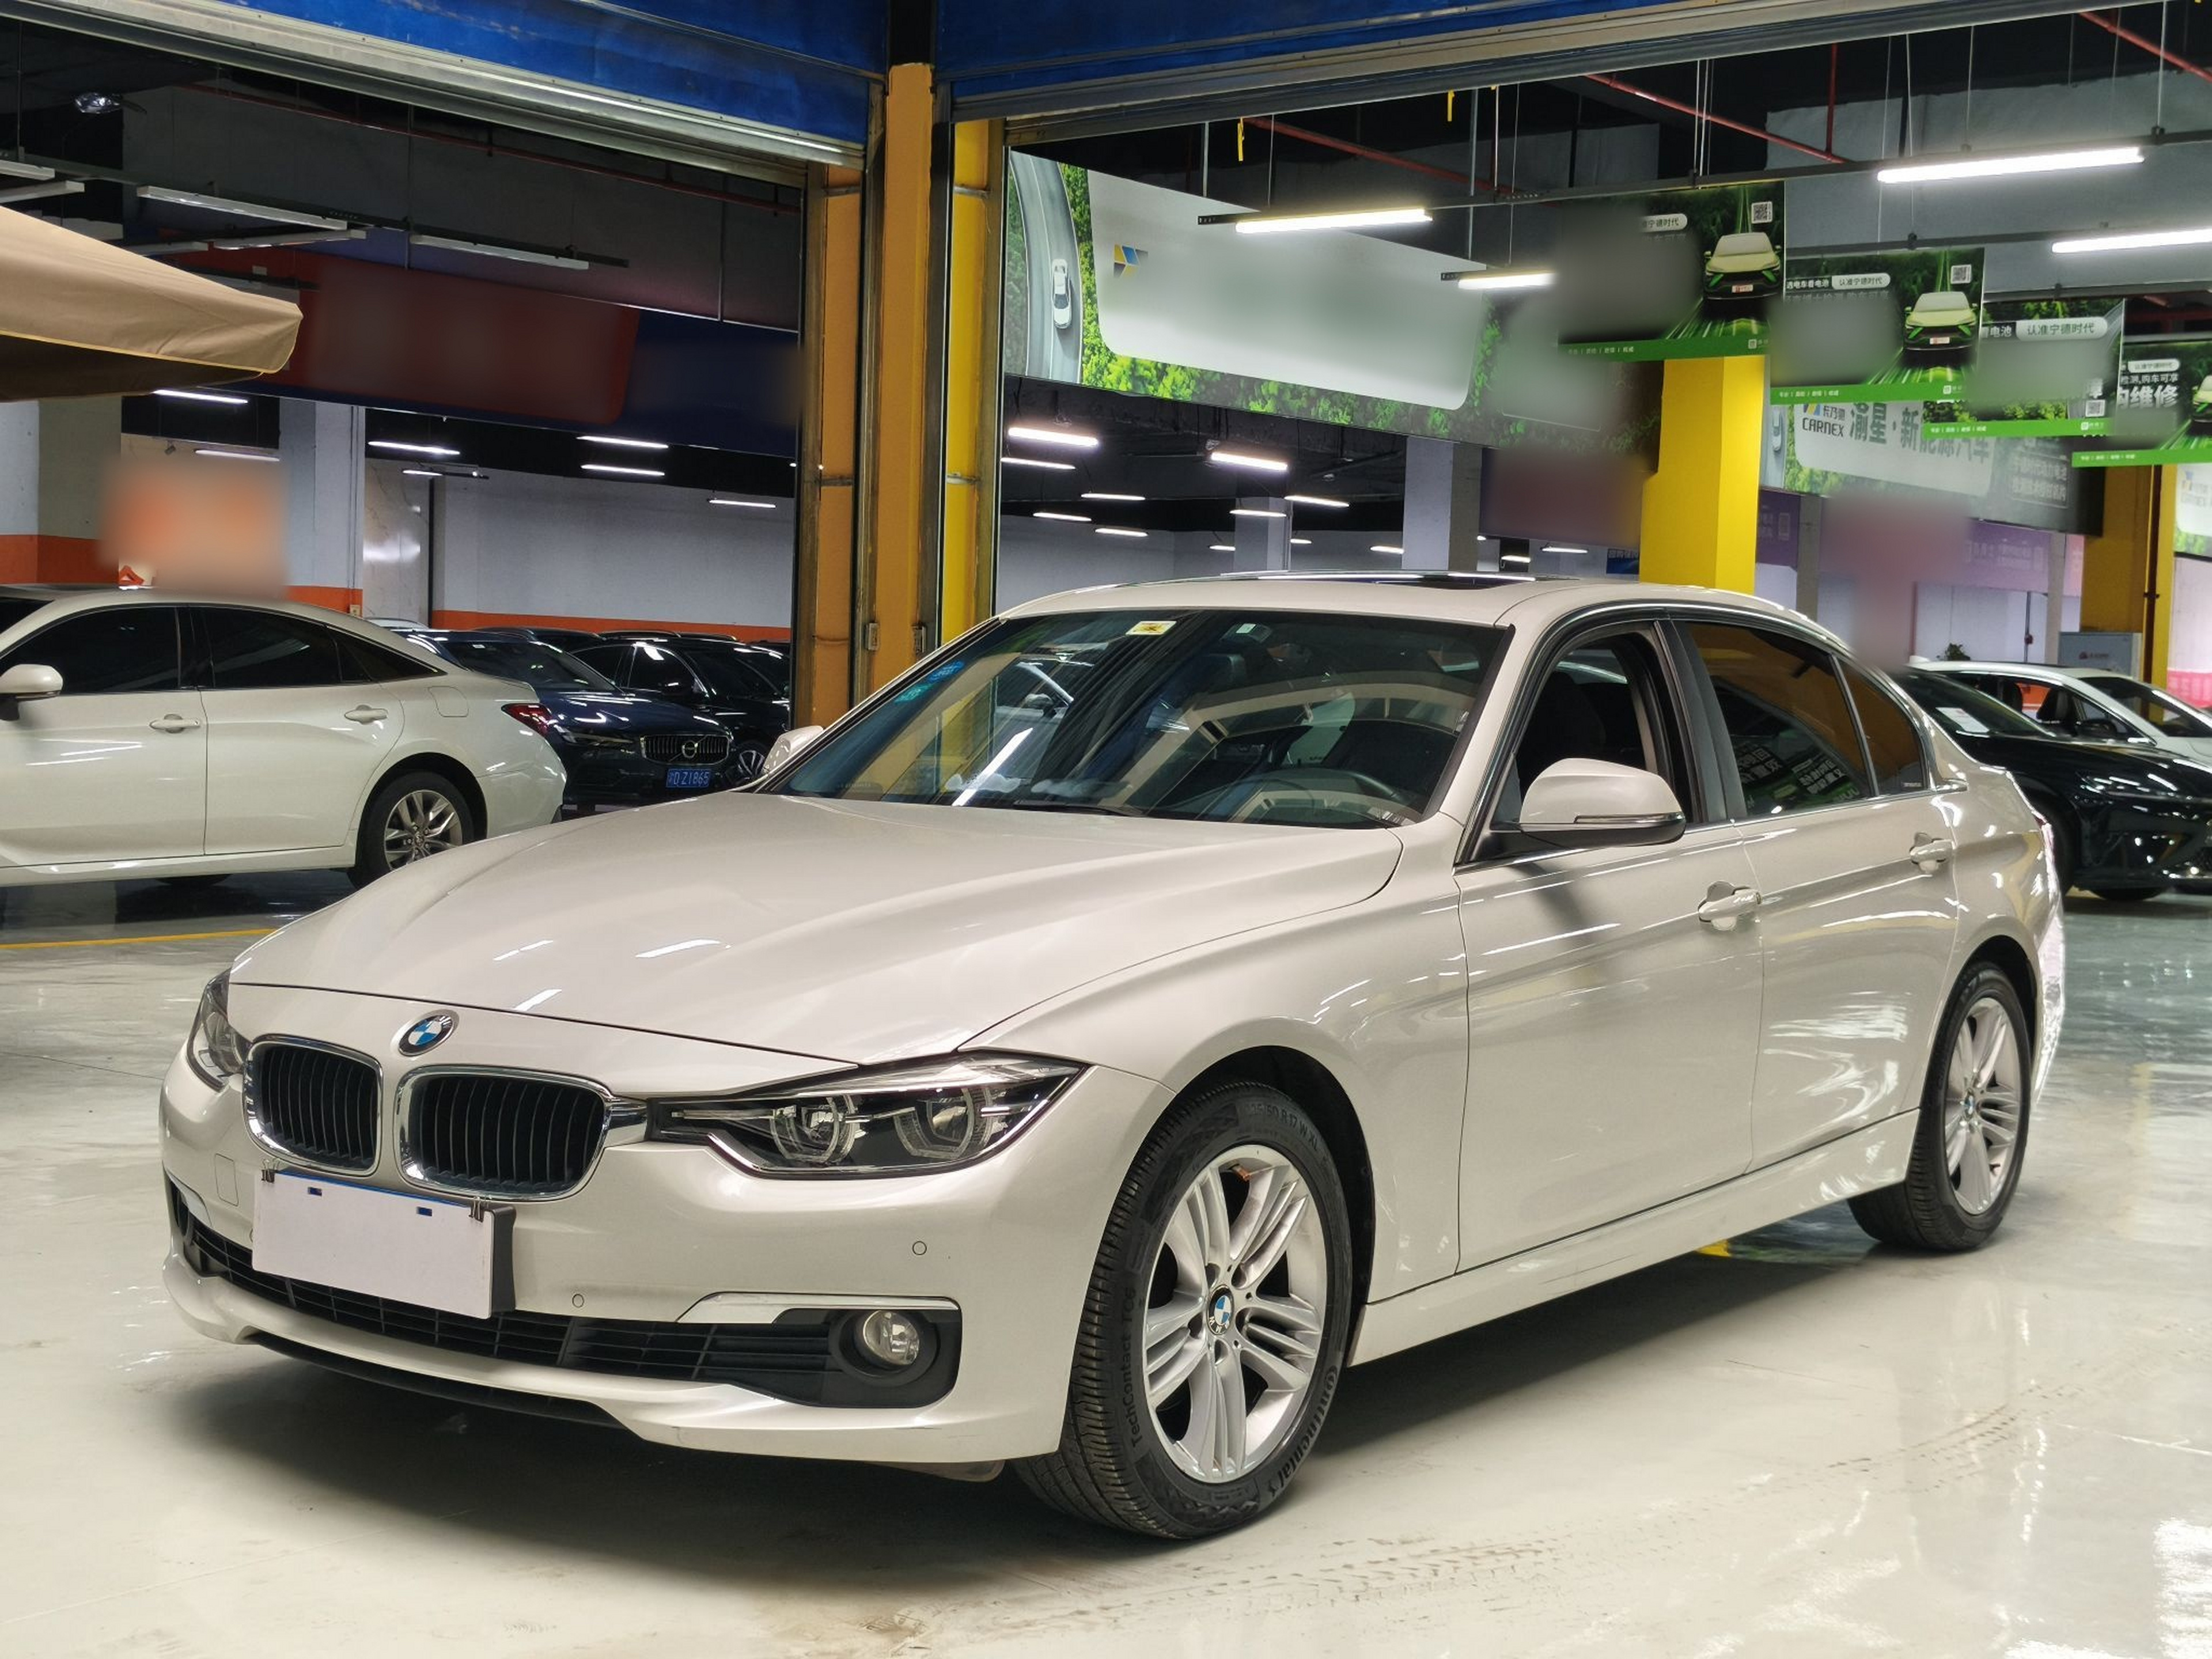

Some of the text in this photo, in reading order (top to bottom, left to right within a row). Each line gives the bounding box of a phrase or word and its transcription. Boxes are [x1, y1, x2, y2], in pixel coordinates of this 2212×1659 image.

[2027, 323, 2094, 336] 认准宁德时代
[1802, 417, 1845, 437] CARNEX
[1121, 1332, 1143, 1447] TechContact
[1278, 1365, 1338, 1488] Continental
